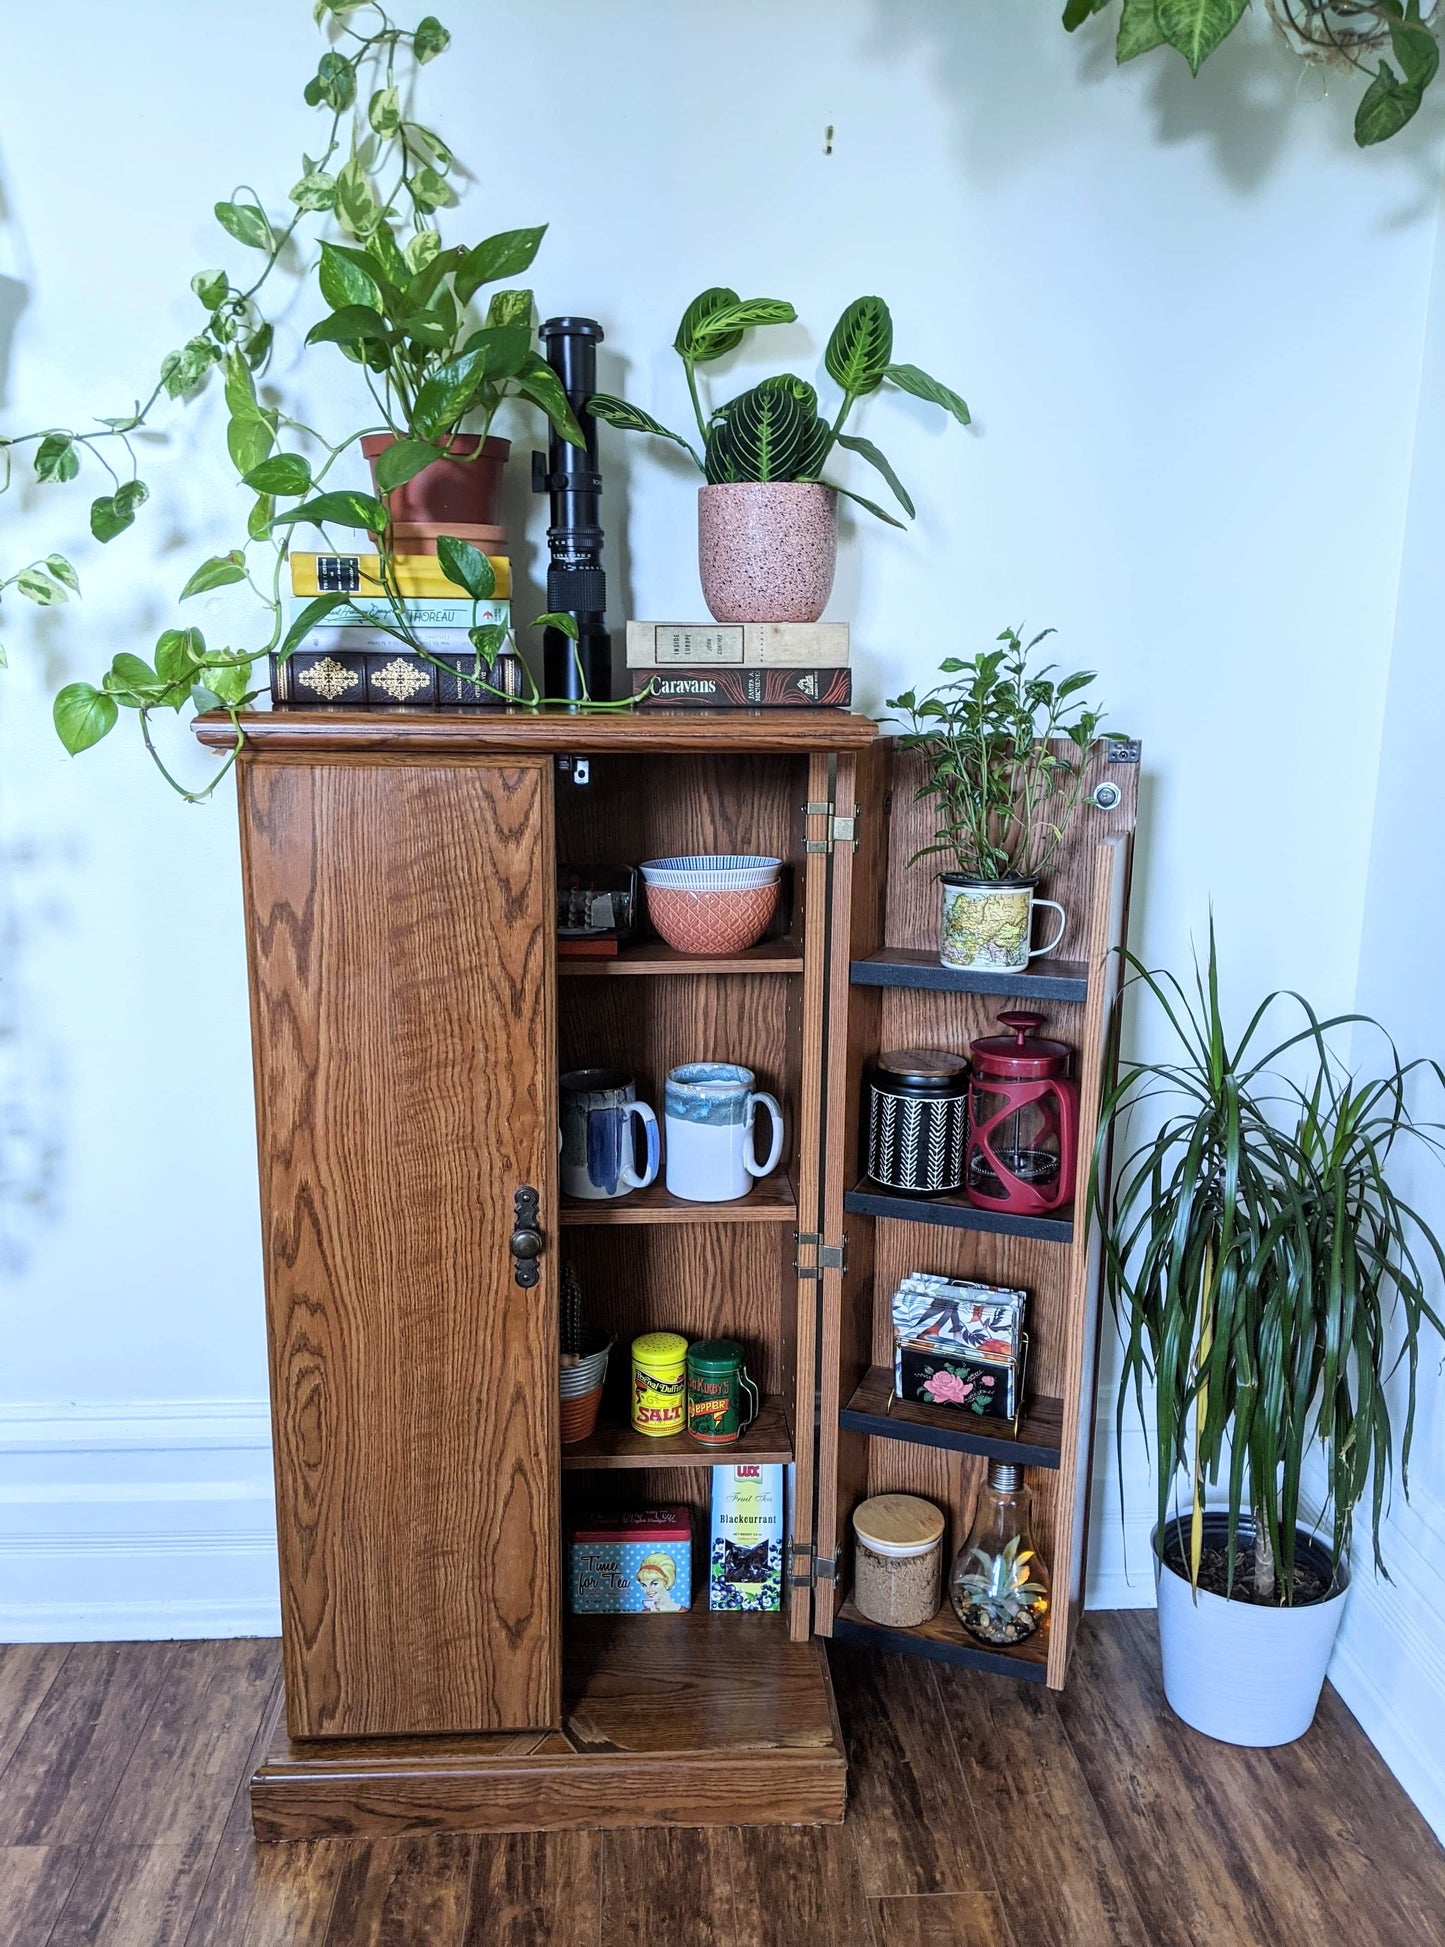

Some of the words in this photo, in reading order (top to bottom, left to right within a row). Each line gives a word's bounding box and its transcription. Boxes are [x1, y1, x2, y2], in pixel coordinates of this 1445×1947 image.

[650, 676, 716, 696] Caravans
[636, 1404, 682, 1423] SALT
[725, 1491, 753, 1503] Fruit
[719, 1514, 777, 1524] Blackcurrant
[580, 1555, 618, 1572] Time
[578, 1572, 599, 1596] for
[601, 1572, 631, 1589] Tea
